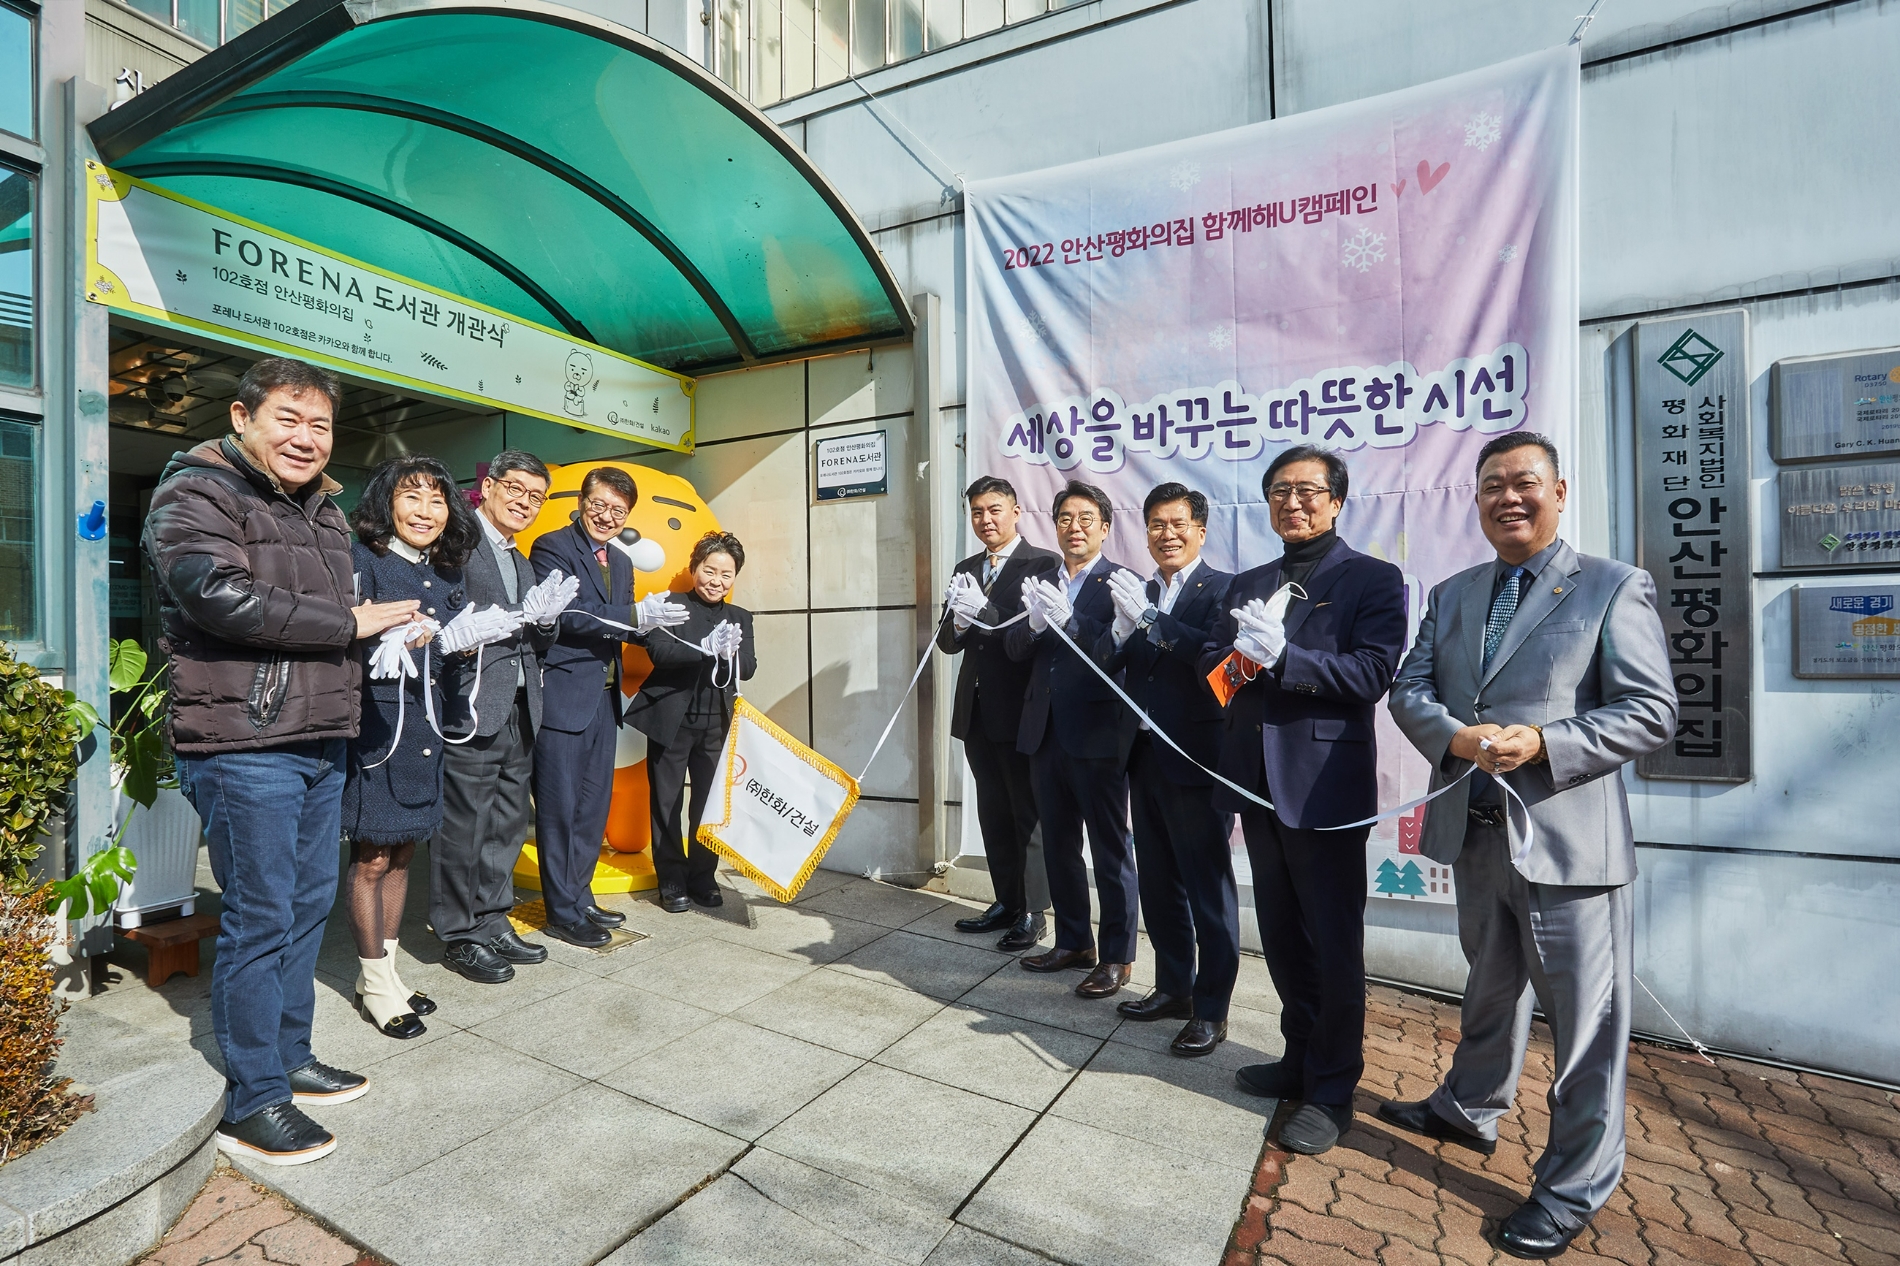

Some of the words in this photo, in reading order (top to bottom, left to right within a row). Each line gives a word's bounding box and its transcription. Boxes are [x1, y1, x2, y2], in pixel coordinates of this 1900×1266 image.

[1003, 244, 1055, 271] 2022
[1060, 216, 1195, 266] 안산평화의집
[1202, 182, 1378, 241] 함께해U캠페인
[211, 228, 364, 303] FORENA
[373, 285, 441, 327] 도서관
[447, 309, 505, 348] 개관식
[212, 266, 268, 296] 102호점
[274, 284, 354, 322] 안산평화의집
[211, 303, 241, 321] 포레나
[243, 312, 271, 329] 도서관
[273, 321, 316, 343] 102호점은
[318, 335, 350, 352] 카카오와
[351, 343, 366, 357] 함께
[367, 348, 393, 364] 합니다.
[1854, 373, 1888, 383] Rotary
[1879, 394, 1900, 404] 안산평
[650, 424, 671, 436] kakao
[1006, 397, 1123, 463] 세상을
[1131, 390, 1258, 449] 바꾸는
[1269, 372, 1413, 440] 따뜻한
[1423, 354, 1515, 421] 시선
[1661, 398, 1690, 492] 평화재단
[1697, 394, 1727, 489] 사회복지법인
[1834, 440, 1855, 449] Gary
[1878, 437, 1900, 445] Huan
[1788, 502, 1837, 516] 아름다운
[1841, 500, 1879, 513] 우리의
[1884, 499, 1900, 510] 미
[1668, 496, 1729, 758] 안산평화의집
[1831, 596, 1864, 609] 새로운
[1869, 596, 1892, 609] 경기
[1853, 623, 1888, 636] 공정한
